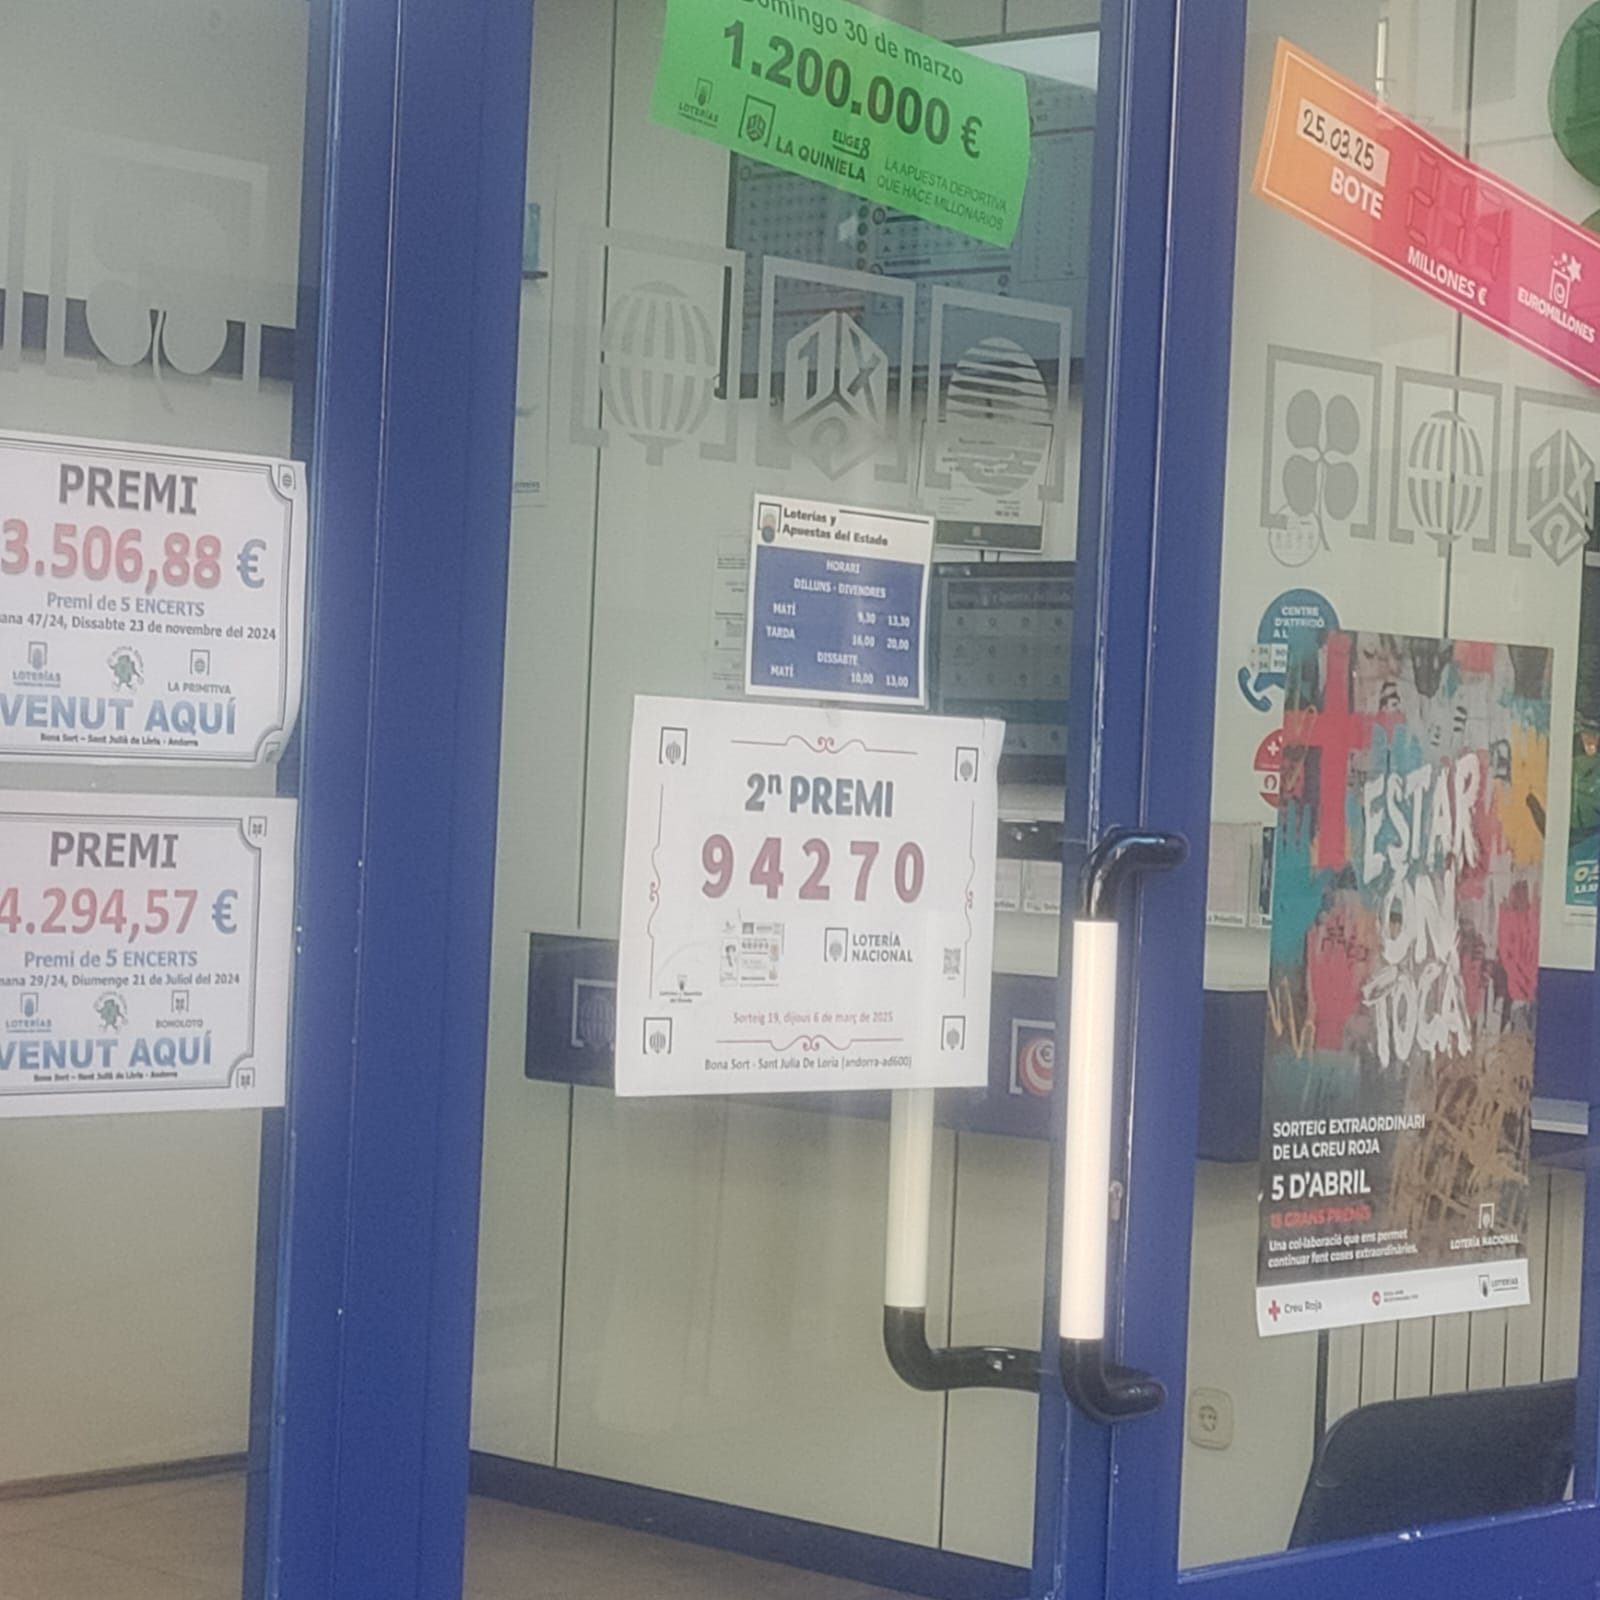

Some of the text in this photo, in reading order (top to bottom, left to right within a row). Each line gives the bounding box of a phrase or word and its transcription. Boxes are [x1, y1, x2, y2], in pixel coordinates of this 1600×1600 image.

[743, 0, 963, 86] omingo 30 de marzo
[724, 19, 983, 159] 1.200.000 €
[1302, 108, 1376, 172] 25.03.25
[776, 136, 865, 184] LA QUINIELA
[885, 157, 1007, 214] LA APUESTA DEPORTIVA
[1330, 167, 1384, 220] BOTE
[877, 175, 1004, 231] QUE HACE MILLONARIOS
[1408, 246, 1476, 299] MILLONES
[1517, 286, 1595, 343] EUROMILLONES
[58, 463, 199, 516] PREMI
[830, 515, 836, 525] y
[783, 523, 888, 546] Apuestas del Estado
[1, 518, 267, 595] 3.506,88 €
[826, 560, 860, 574] HORARI
[794, 578, 832, 593] DILLUNS
[838, 582, 886, 598] DIVENDRES
[47, 592, 205, 617] Premi de 5 ENCERTS
[773, 602, 796, 616] MATÍ
[27, 612, 68, 630] 47/24,
[72, 615, 125, 631] Dissabte
[130, 619, 144, 632] 23
[148, 620, 162, 633] de
[166, 623, 222, 637] novembre
[226, 625, 243, 638] del
[247, 627, 276, 640] 2024
[766, 625, 795, 639] TARDA
[770, 664, 794, 677] MATÍ
[168, 682, 231, 694] LA PRIMITIVA
[0, 693, 236, 736] VENUT AQUÍ
[789, 776, 894, 818] PREMI
[1362, 753, 1482, 885] ESTAR
[50, 831, 179, 869] PREMI
[0, 887, 238, 943] 4.294,57 €
[853, 931, 901, 948] LOTERÍA
[24, 948, 198, 968] Premi de 5 ENCERTS
[852, 948, 912, 963] NACIONAL
[30, 974, 68, 988] 29/24,
[72, 974, 129, 988] Diumenge
[132, 973, 146, 986] 21
[149, 973, 163, 985] de
[166, 973, 193, 985] Juliol
[195, 973, 211, 984] del
[215, 973, 240, 984] 2024
[156, 1018, 204, 1029] BONOLOTO
[733, 1011, 894, 1026] Sorteig 19, dijous 6 de març de 2025
[1361, 960, 1472, 1069] TOCA
[0, 1030, 212, 1071] VENUT AQUÍ
[704, 1058, 728, 1070] Bona
[731, 1057, 750, 1069] Sort
[758, 1057, 778, 1069] Sant
[802, 1057, 815, 1068] De
[817, 1056, 839, 1068] Loria
[1273, 1114, 1425, 1138] SORTEIG EXTRAORDINARI
[1273, 1138, 1380, 1161] DE LA CREU ROJA
[1271, 1169, 1371, 1200] 5 D'ABRIL
[1269, 1239, 1287, 1252] Una
[1344, 1234, 1360, 1247] que
[1361, 1231, 1376, 1243] ens
[1378, 1228, 1408, 1244] permet
[1450, 1235, 1480, 1250] LOTERÍA
[1268, 1253, 1310, 1268] continuar
[1311, 1251, 1329, 1265] fent
[1284, 1299, 1322, 1314] Creu Roja
